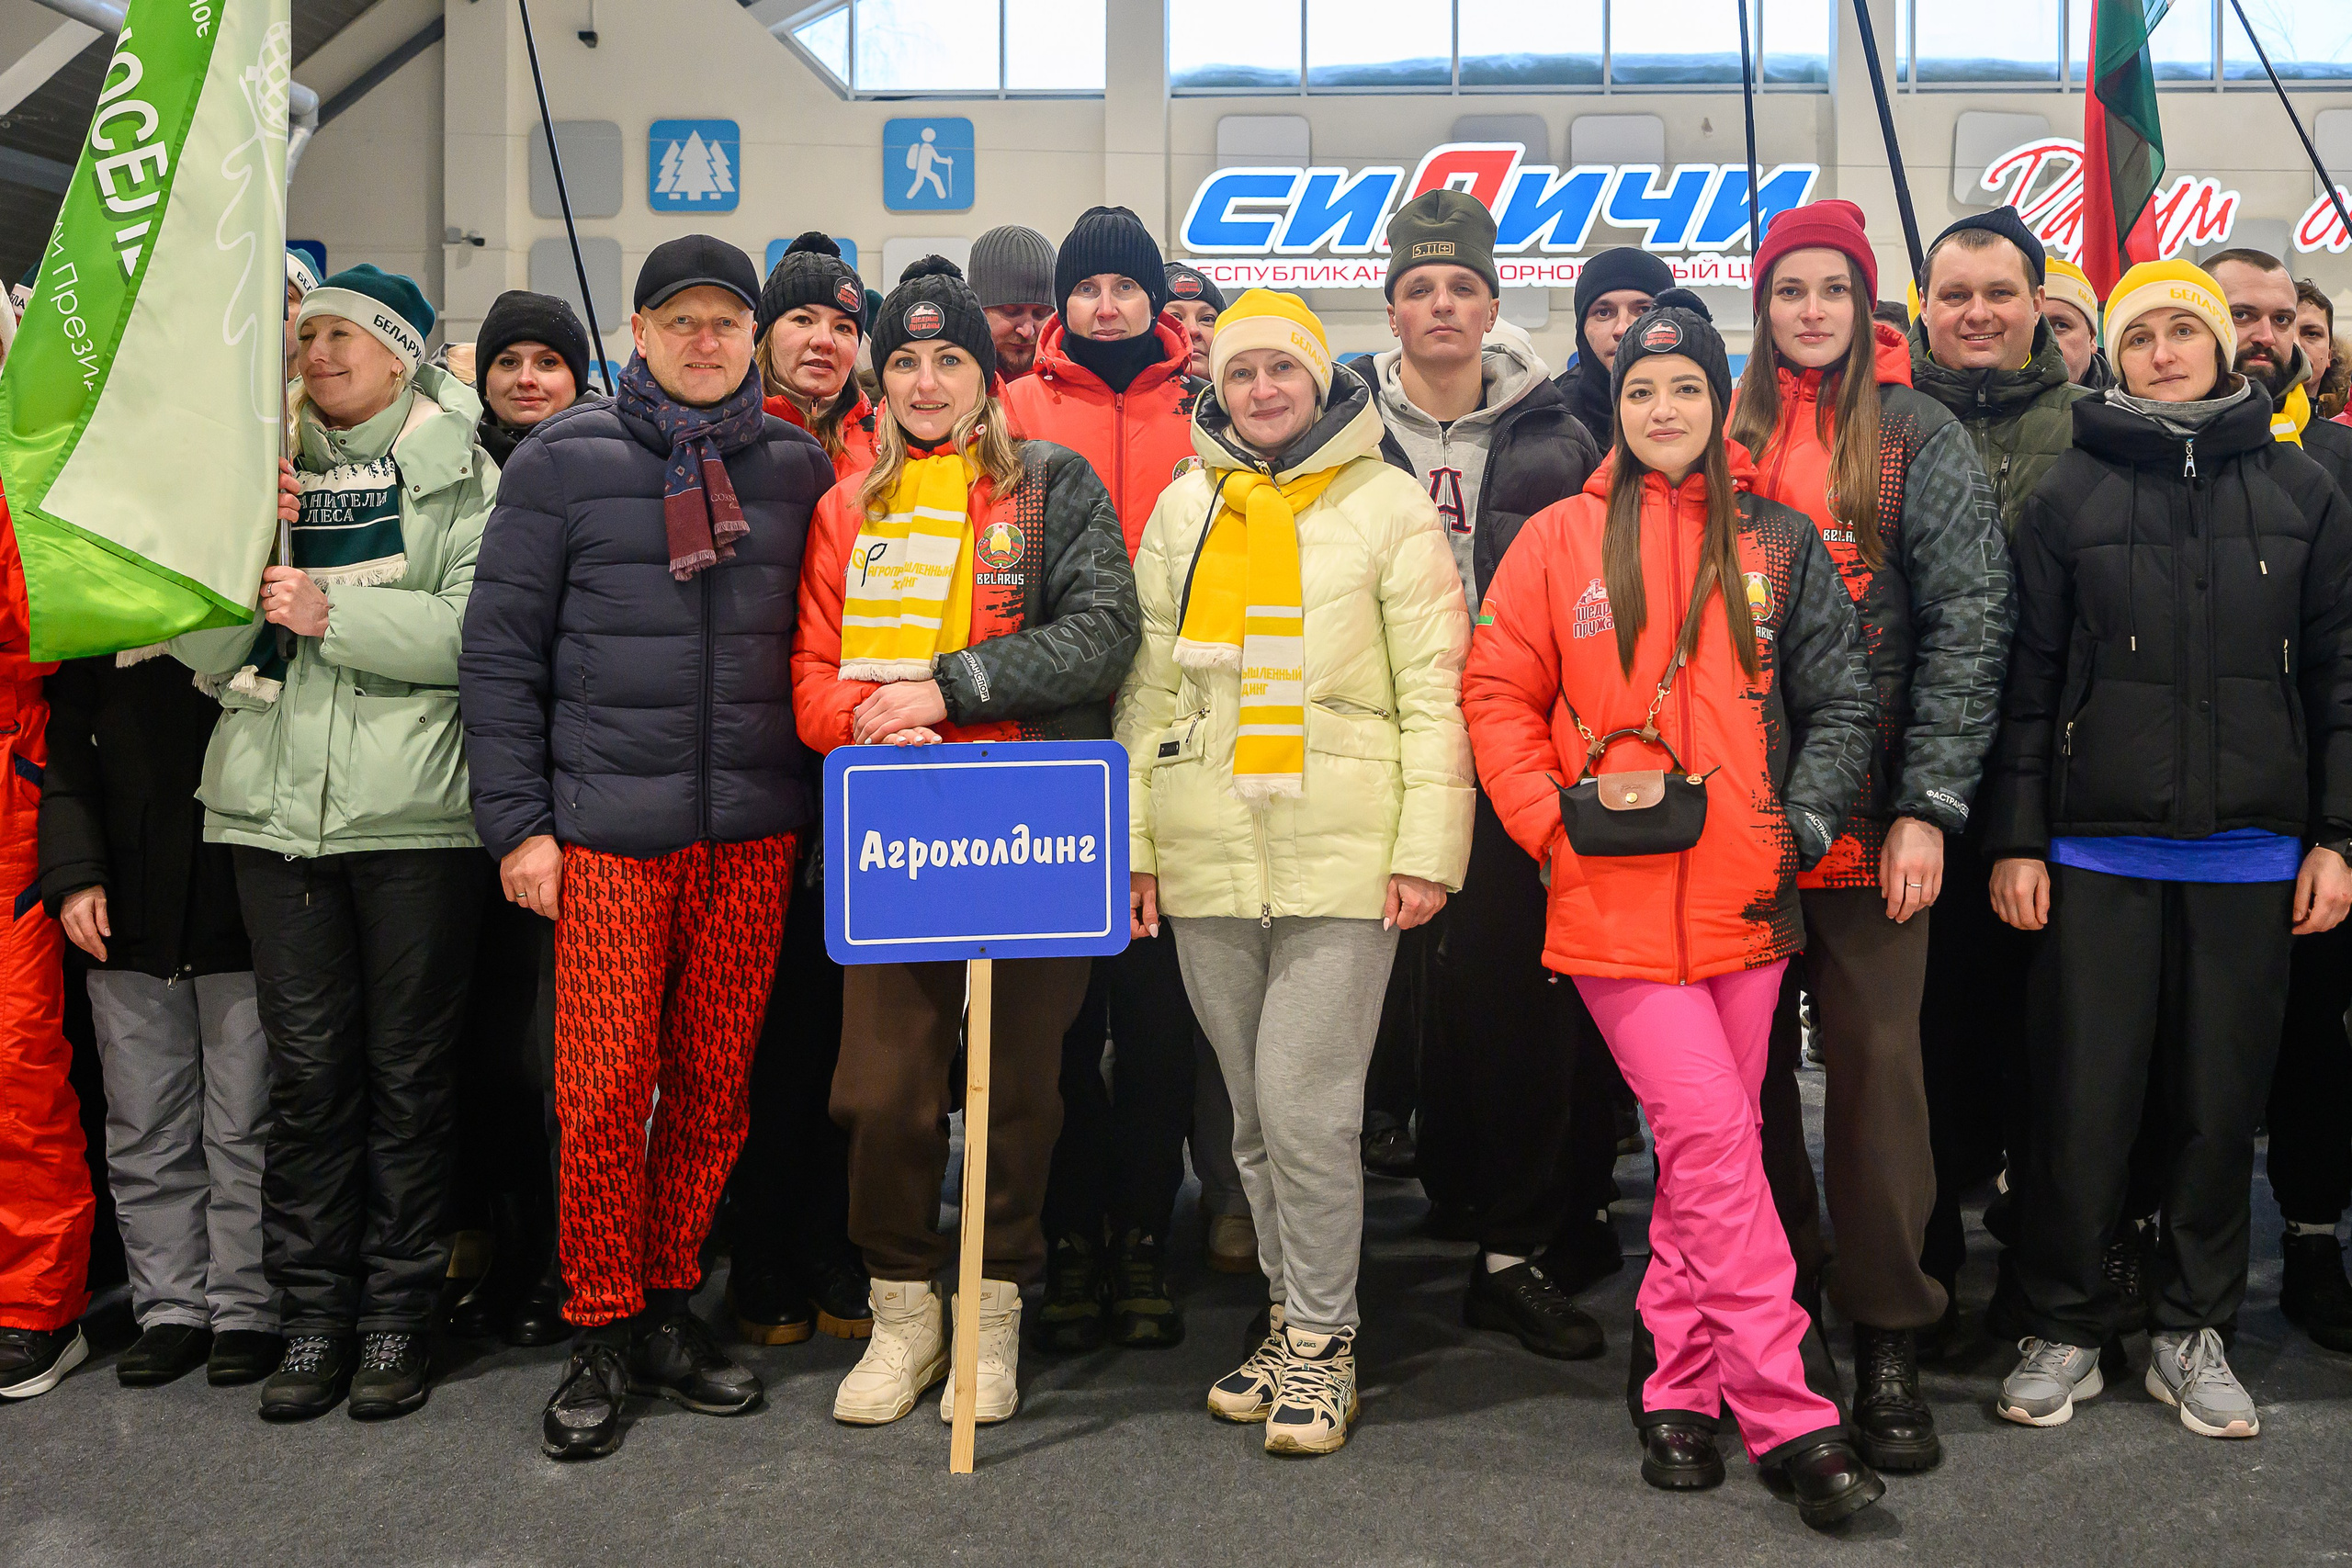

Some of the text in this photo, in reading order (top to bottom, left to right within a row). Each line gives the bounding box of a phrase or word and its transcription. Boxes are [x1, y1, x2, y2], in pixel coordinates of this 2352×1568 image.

[305, 508, 355, 524] ЛЕСА
[976, 573, 1025, 585] BELARUS
[858, 823, 1097, 881] Агрохолдинг
